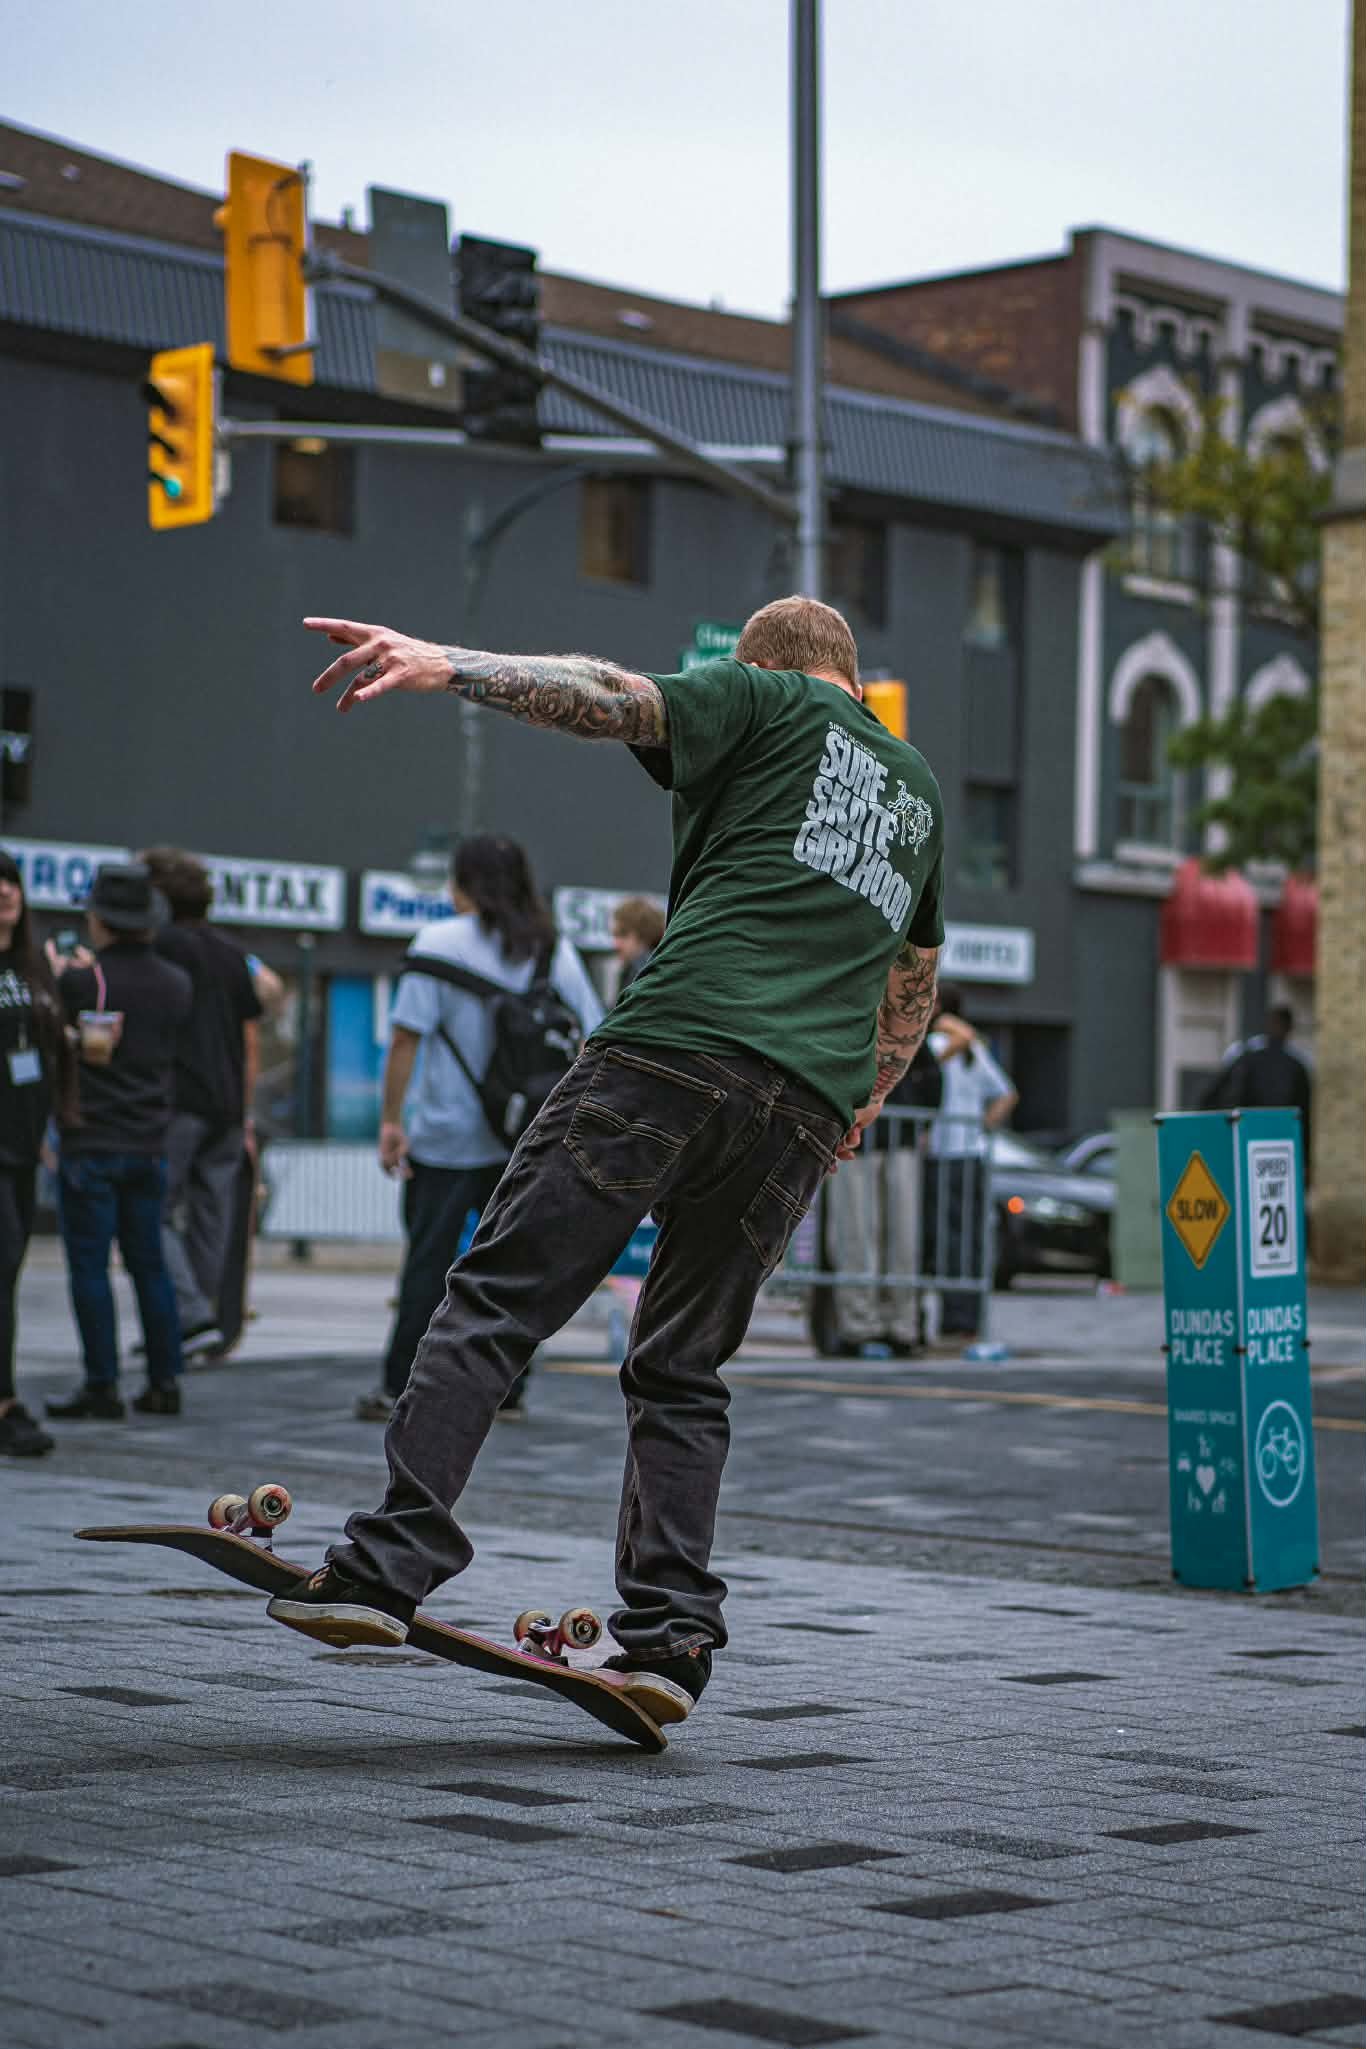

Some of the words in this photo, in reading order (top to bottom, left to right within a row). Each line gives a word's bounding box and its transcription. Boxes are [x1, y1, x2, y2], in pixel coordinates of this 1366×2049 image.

[819, 730, 889, 803] SURF
[805, 775, 894, 859] SKATE
[1256, 1158, 1288, 1178] SPEED
[1259, 1179, 1284, 1200] LIMIT
[1176, 1199, 1218, 1222] SLOW
[1259, 1203, 1288, 1247] 20
[1171, 1307, 1234, 1336] DUNDAS
[1248, 1305, 1302, 1333] DUNDAS
[1171, 1338, 1224, 1365] PLACE
[1248, 1336, 1294, 1365] PLACE
